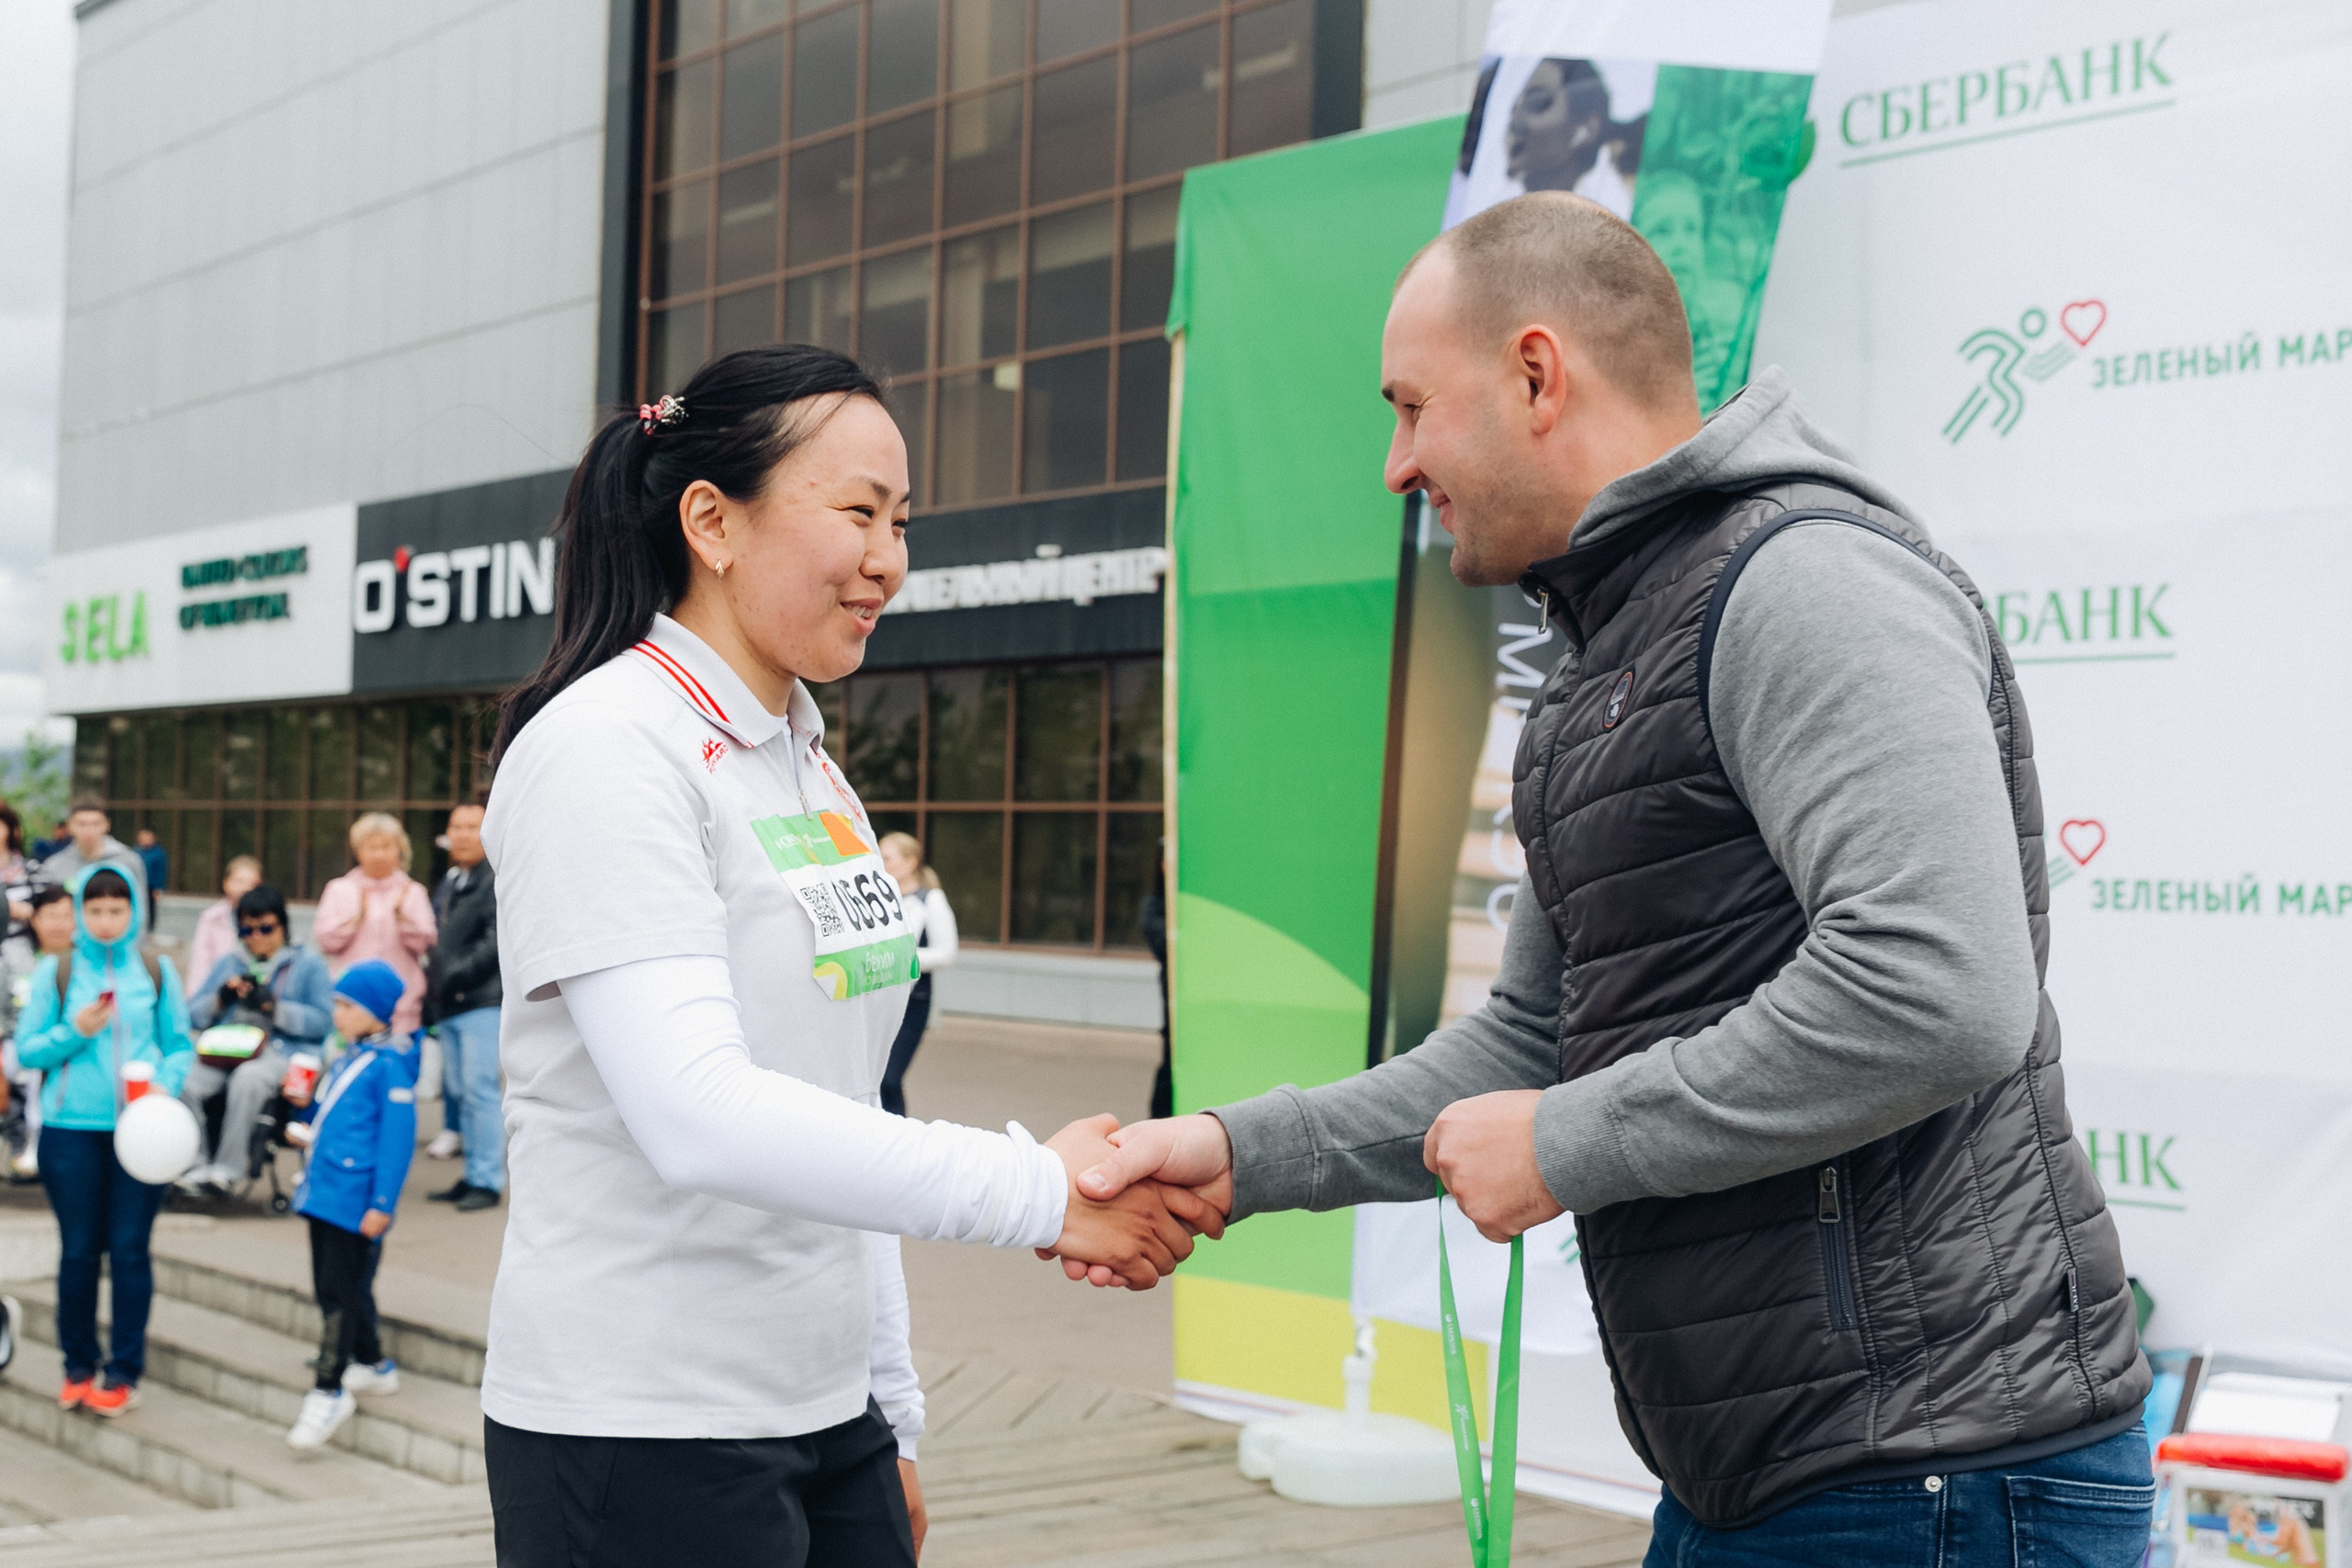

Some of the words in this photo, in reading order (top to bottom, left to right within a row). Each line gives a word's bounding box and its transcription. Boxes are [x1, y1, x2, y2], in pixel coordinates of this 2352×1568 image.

[1839, 31, 2173, 150] СБЕРБАНК
[2091, 332, 2262, 389] ЗЕЛЕНЫЙ
[61, 591, 149, 662] SELA
[1984, 582, 2173, 645] БАНК
[2090, 873, 2262, 913] ЗЕЛЕНЫЙ
